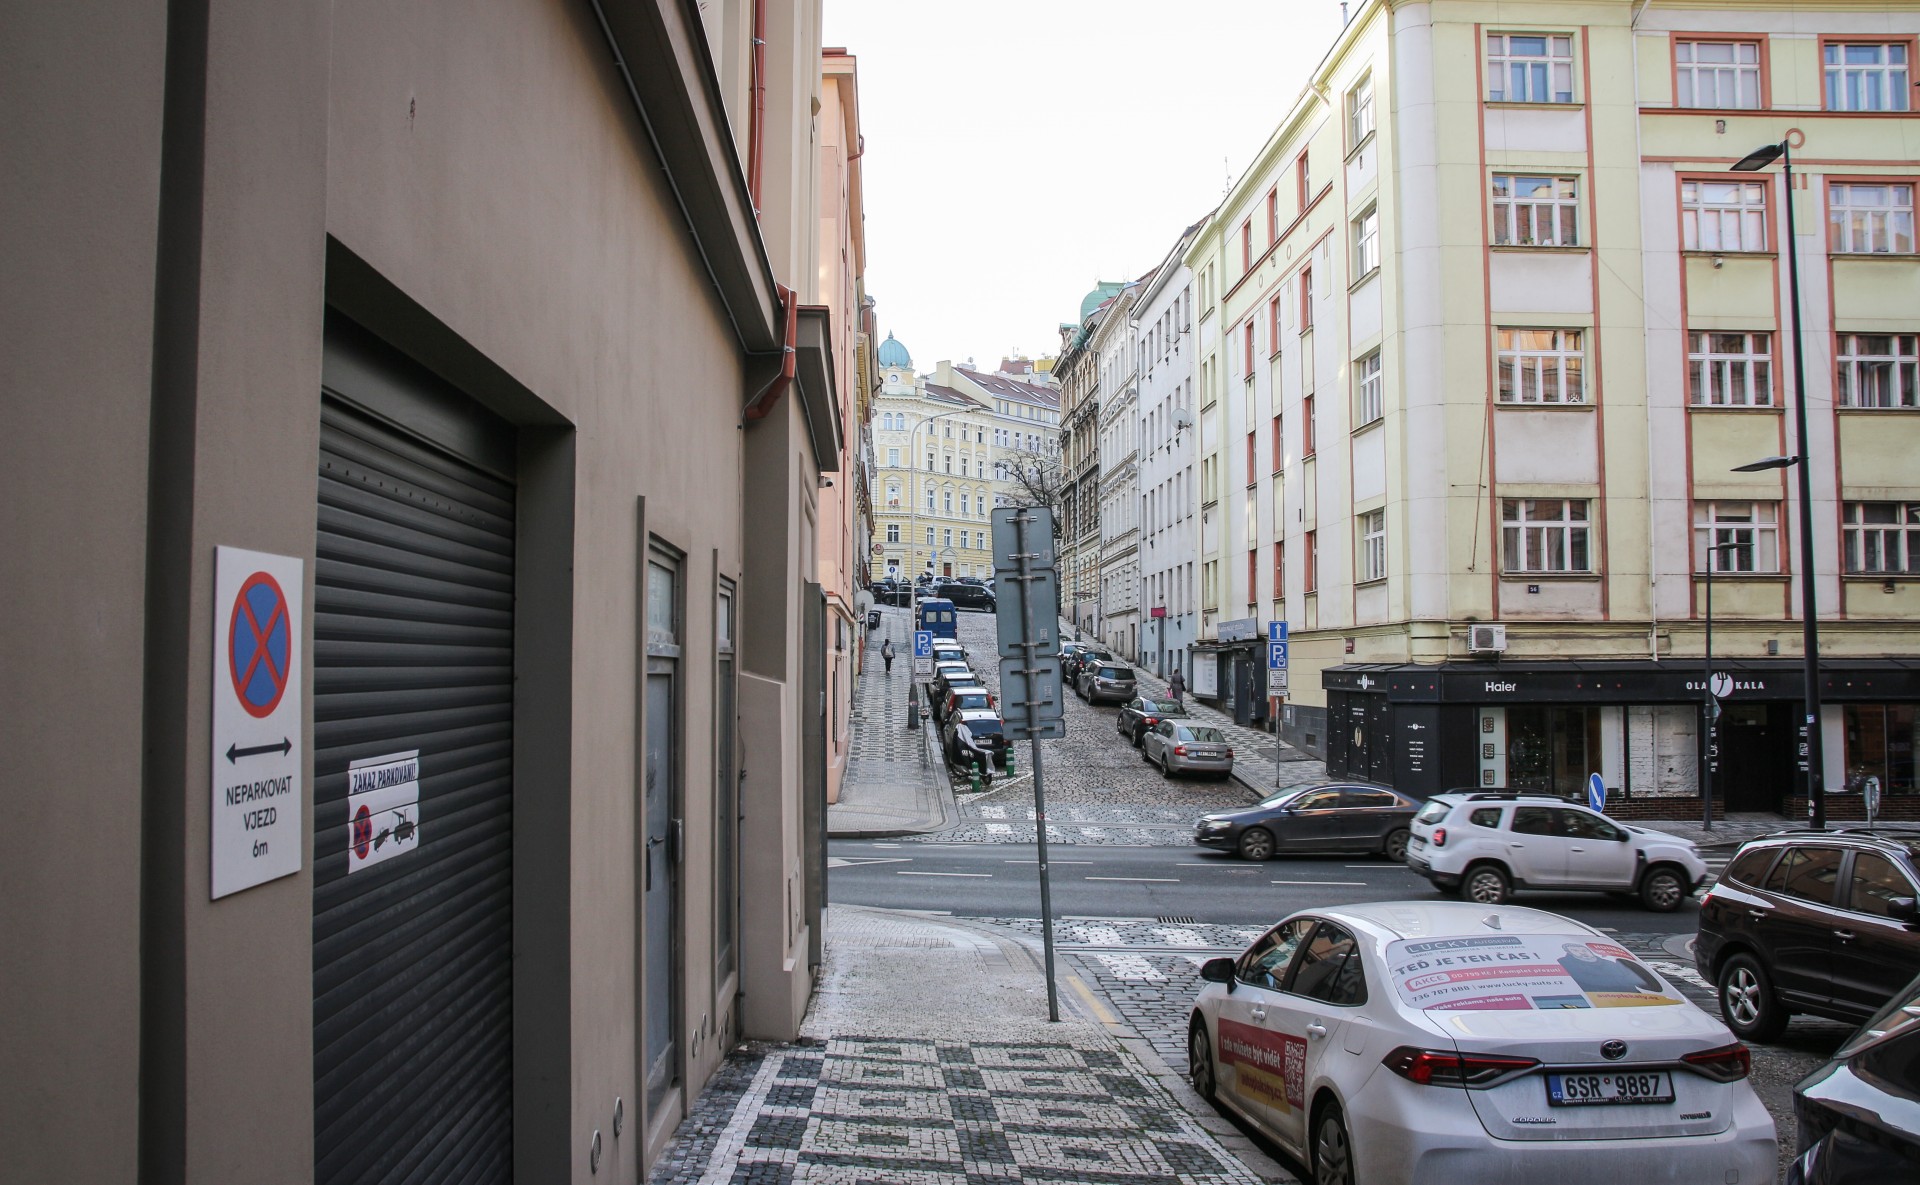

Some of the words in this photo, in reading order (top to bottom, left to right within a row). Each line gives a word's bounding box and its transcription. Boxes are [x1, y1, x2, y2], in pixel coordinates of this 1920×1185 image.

[1485, 681, 1516, 692] Haier
[1686, 681, 1707, 690] OLA
[1735, 681, 1765, 690] KALA
[353, 769, 376, 793] ZÁKAZ
[378, 761, 416, 788] PARKOVÁNÍ!
[226, 776, 292, 807] NEPARKOVAT
[244, 807, 277, 831] VJEZD
[253, 839, 268, 858] 6m
[1408, 940, 1470, 953] LUCKY
[1395, 959, 1430, 975] TEĎ
[1437, 957, 1454, 966] JE
[1457, 953, 1492, 964] TEN
[1497, 952, 1531, 961] ČAS
[1412, 992, 1430, 1002] 736
[1431, 988, 1448, 997] 787
[1452, 985, 1470, 993] 888
[1478, 980, 1564, 990] www.lucky-auto.cz
[1415, 975, 1445, 987] AKCE
[1224, 1037, 1233, 1052] zde
[1233, 1039, 1252, 1059] můžete
[1252, 1045, 1263, 1065] být
[1263, 1048, 1281, 1069] vidět
[1565, 1076, 1602, 1098] 6SR
[1615, 1075, 1660, 1096] 9887
